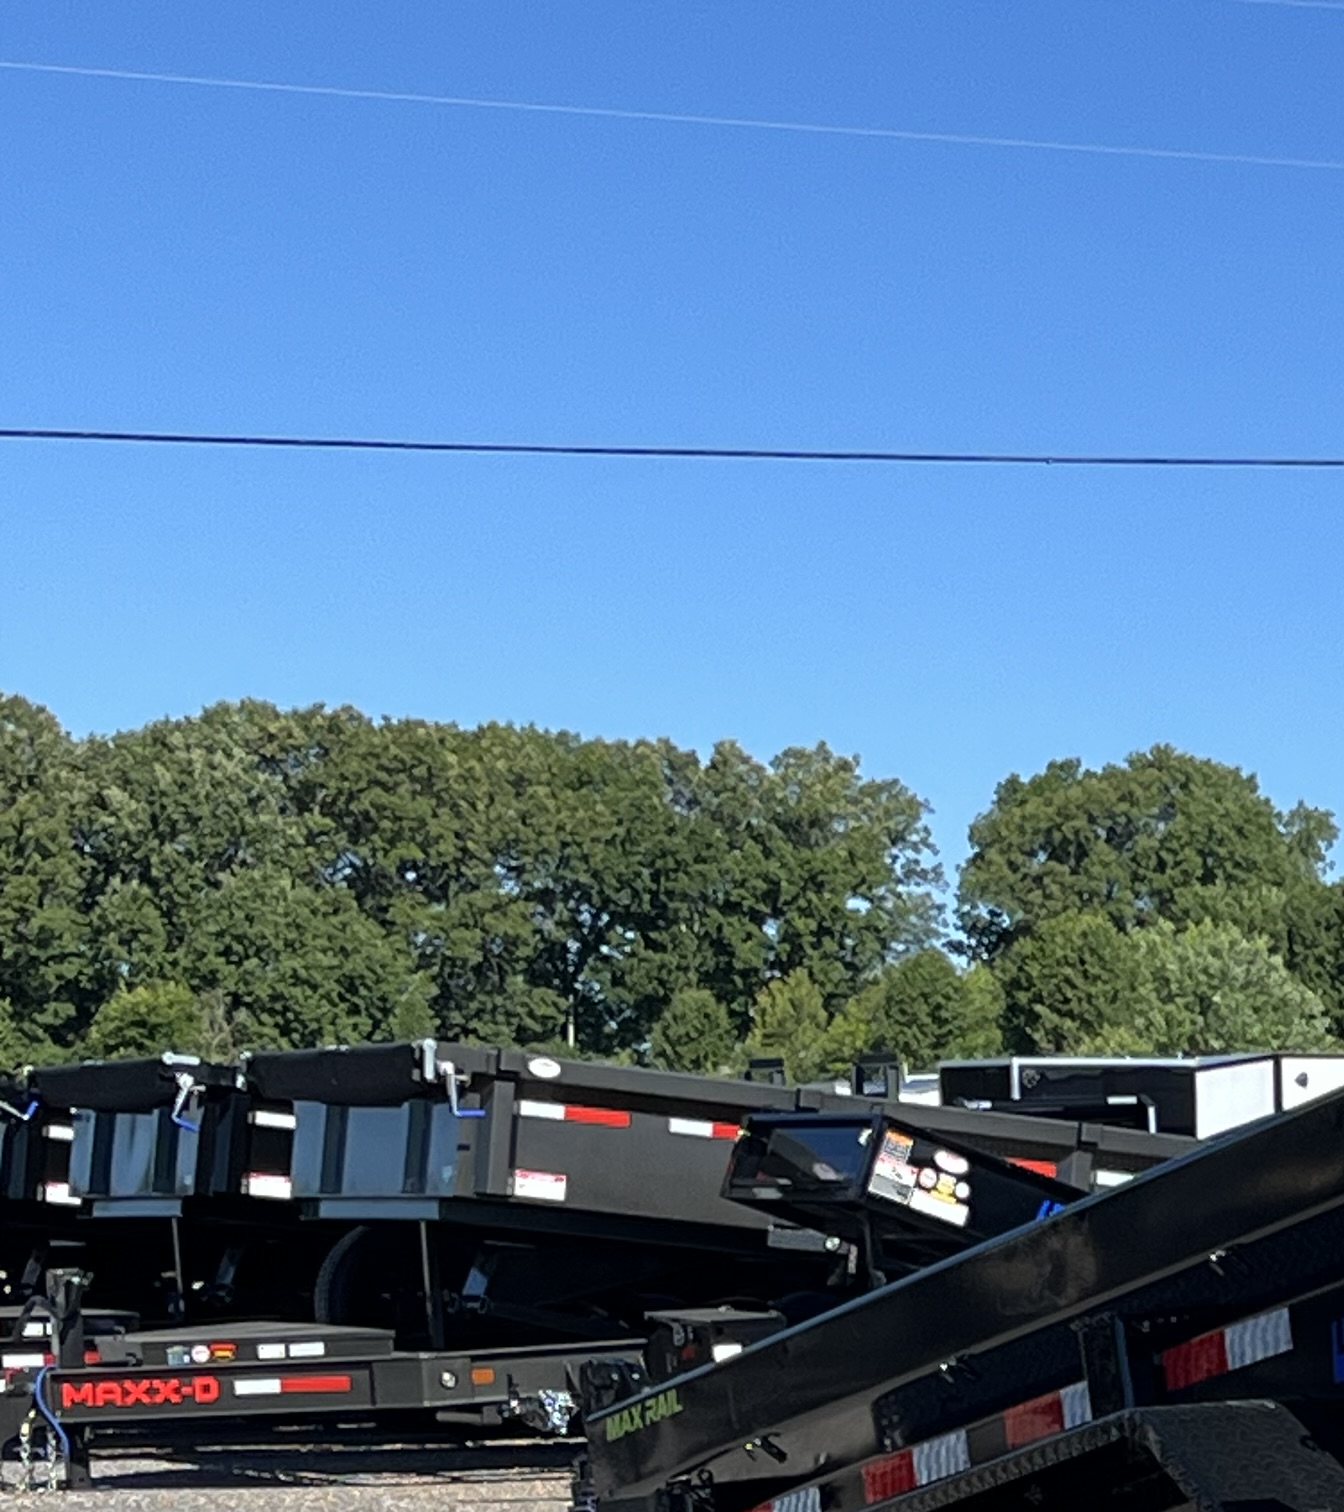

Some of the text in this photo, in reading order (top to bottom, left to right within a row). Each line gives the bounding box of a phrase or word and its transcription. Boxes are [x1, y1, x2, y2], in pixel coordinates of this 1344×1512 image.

[62, 1375, 220, 1408] MAXX-D
[606, 1388, 684, 1442] MAX RAIL
